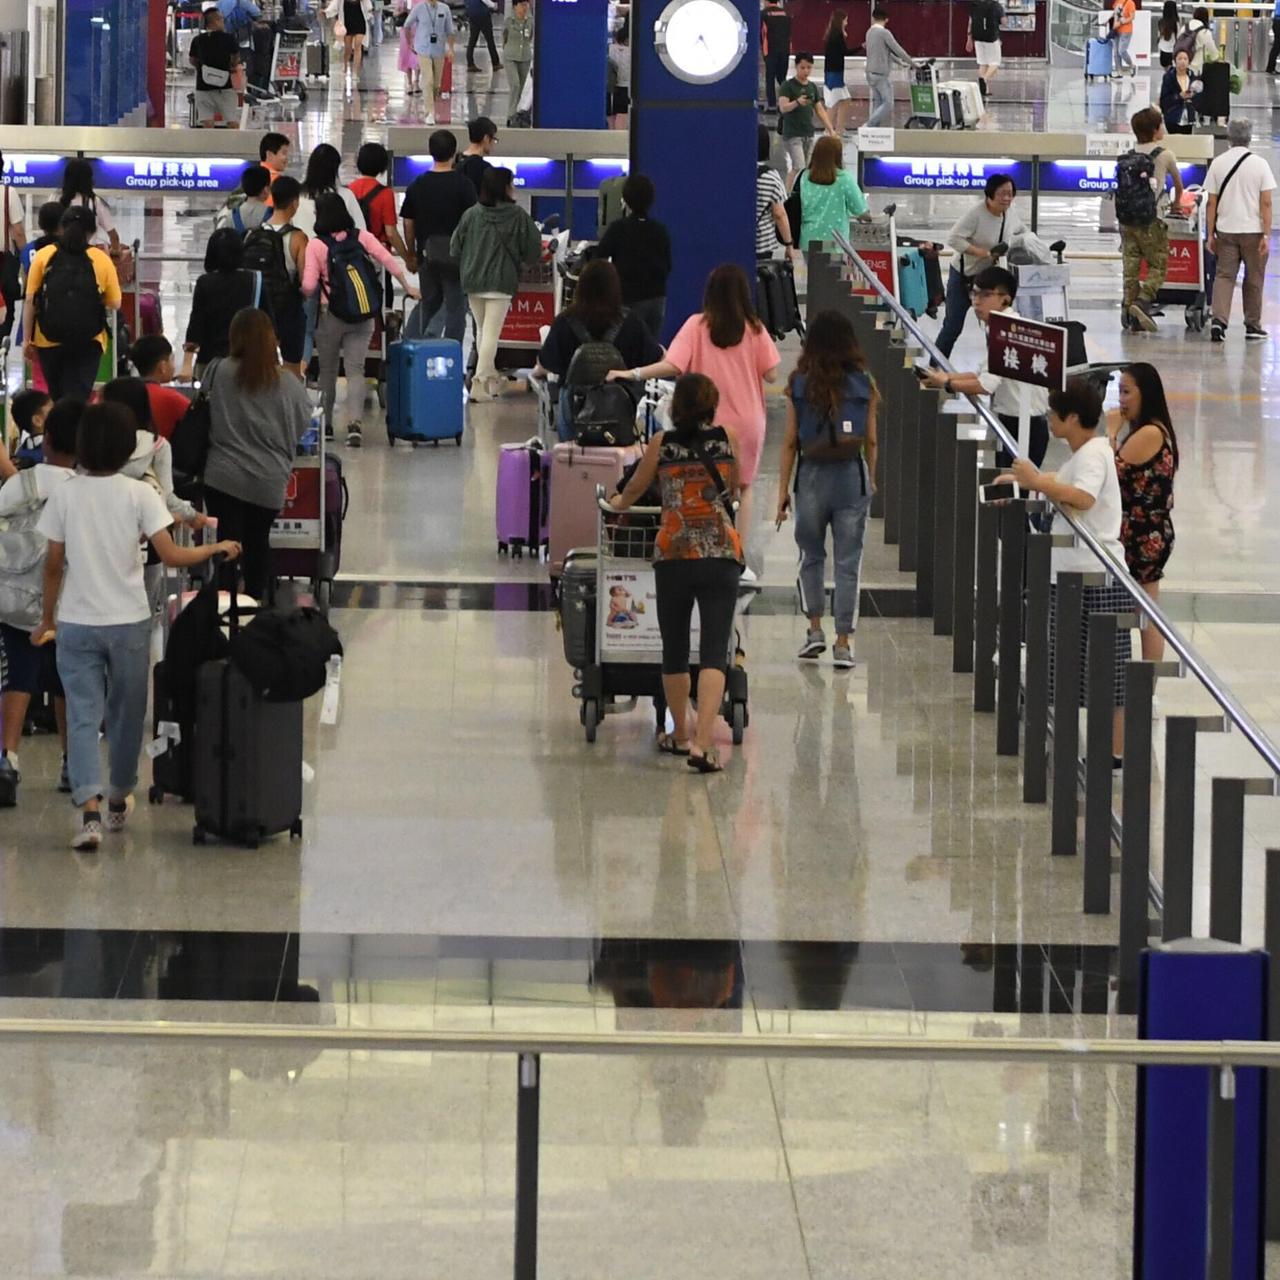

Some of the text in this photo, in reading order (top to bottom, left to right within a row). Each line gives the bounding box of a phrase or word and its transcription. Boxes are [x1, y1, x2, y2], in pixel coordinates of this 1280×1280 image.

[12, 175, 35, 185] area
[126, 175, 219, 189] Group pick-up area
[904, 174, 987, 187] Group pick-up are
[1079, 178, 1107, 191] Group
[1003, 346, 1048, 378] 接機
